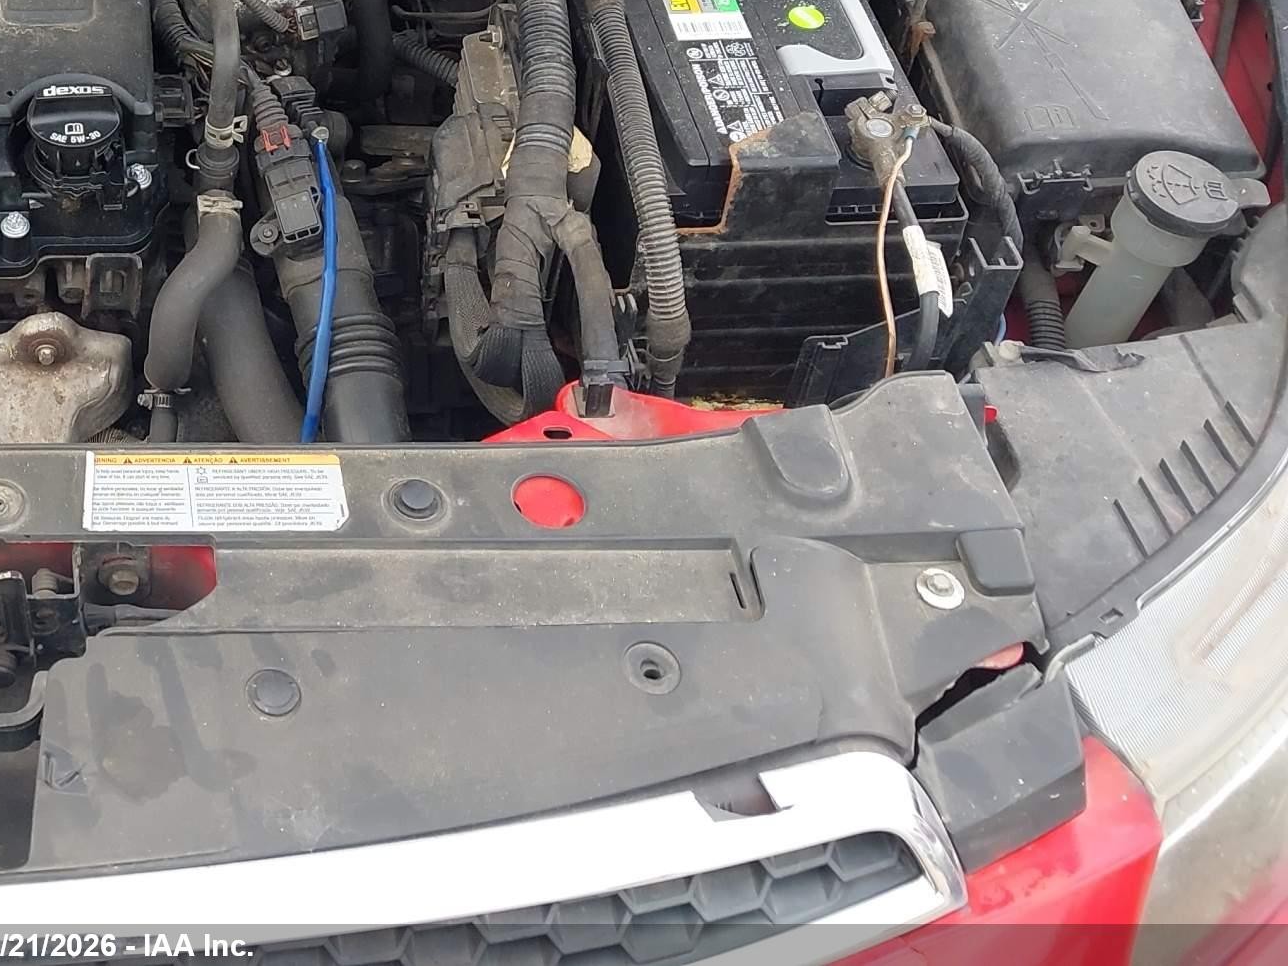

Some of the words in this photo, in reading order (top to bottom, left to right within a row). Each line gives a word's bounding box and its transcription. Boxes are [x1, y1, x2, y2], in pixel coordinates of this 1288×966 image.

[43, 85, 108, 97] dexos
[50, 132, 68, 144] SAE
[70, 130, 101, 144] 5W-30
